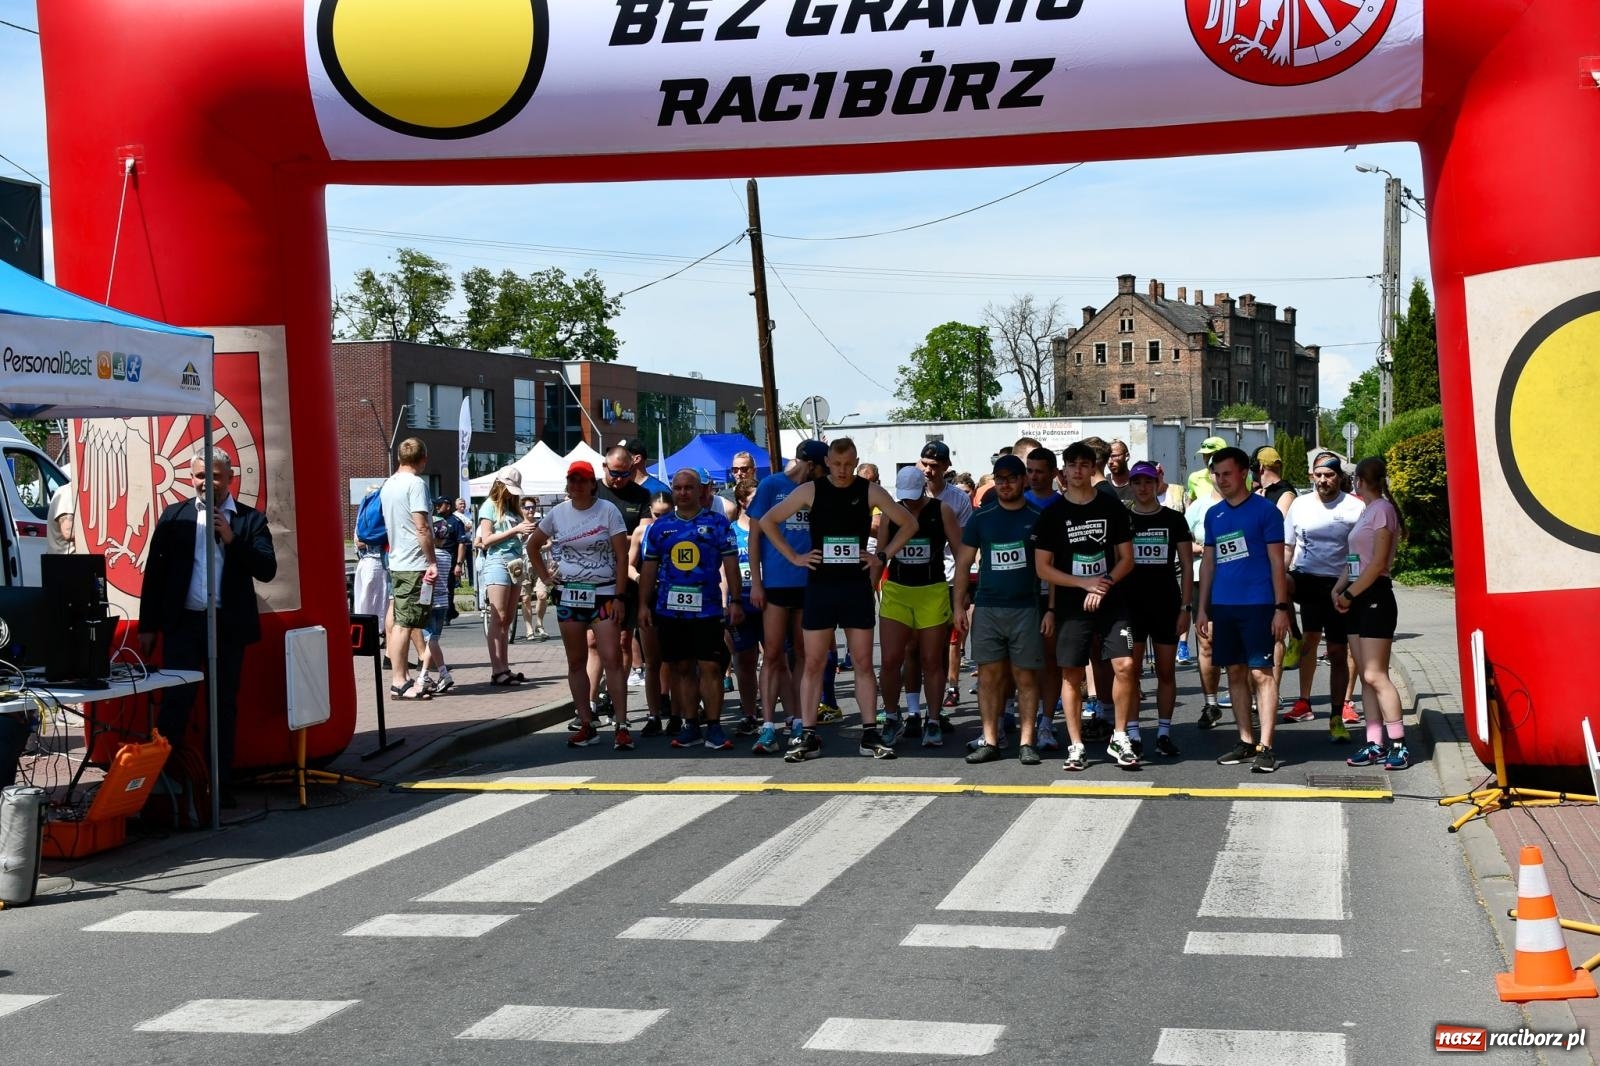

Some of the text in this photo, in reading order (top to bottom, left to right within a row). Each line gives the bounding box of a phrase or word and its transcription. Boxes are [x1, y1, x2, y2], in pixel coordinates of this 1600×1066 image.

[608, 0, 766, 46] BEZ
[657, 50, 1056, 126] RACIBÓRZ
[3, 346, 93, 376] PersonalBest
[181, 373, 201, 386] MITKO
[1021, 428, 1079, 437] Sekcja Podnoszenia
[796, 511, 809, 522] 98
[833, 545, 851, 556] 95
[903, 546, 924, 558] 102
[1137, 545, 1161, 557] 109
[1219, 541, 1237, 555] 85
[996, 550, 1020, 563] 100
[1081, 562, 1101, 575] 110
[569, 590, 587, 601] 114
[677, 593, 693, 605] 83
